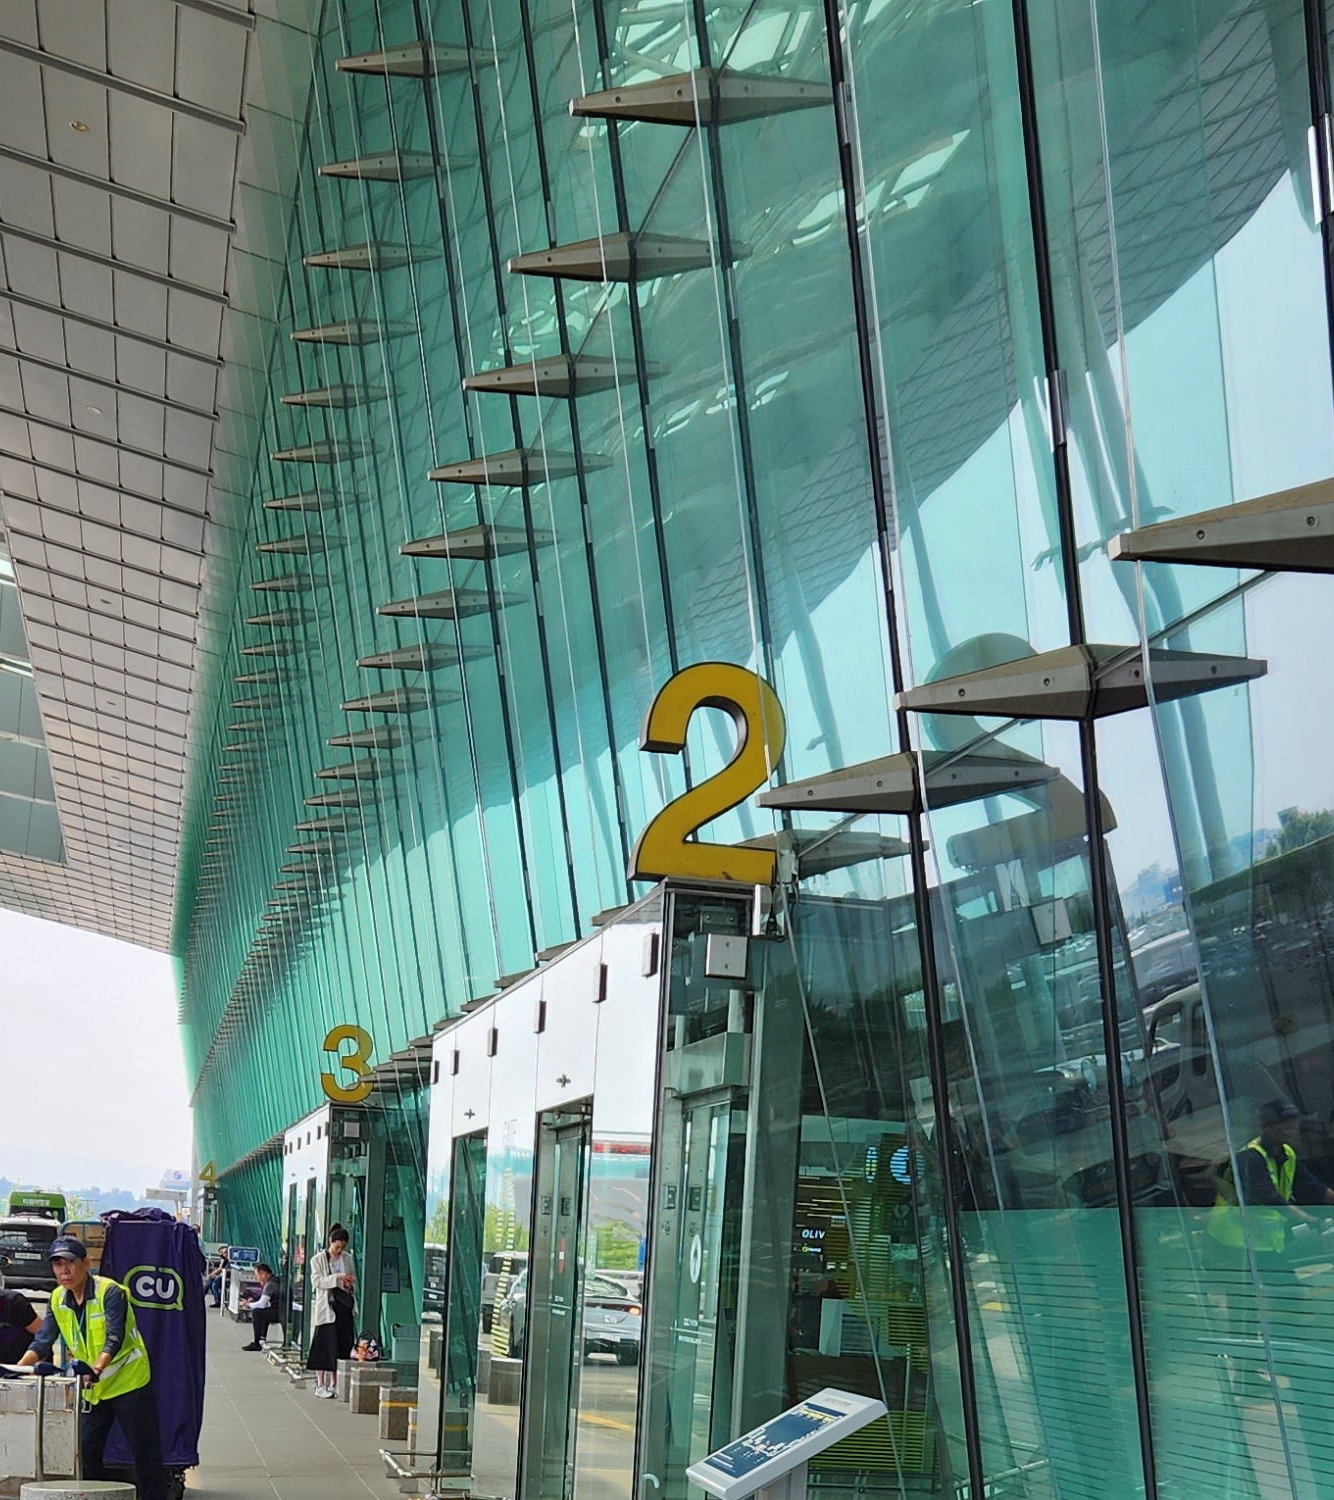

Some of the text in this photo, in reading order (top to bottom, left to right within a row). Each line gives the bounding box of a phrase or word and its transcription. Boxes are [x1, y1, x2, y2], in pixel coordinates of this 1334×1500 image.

[630, 660, 786, 886] 2
[321, 1024, 375, 1103] 3
[199, 1160, 216, 1187] 4
[136, 1275, 174, 1299] CU
